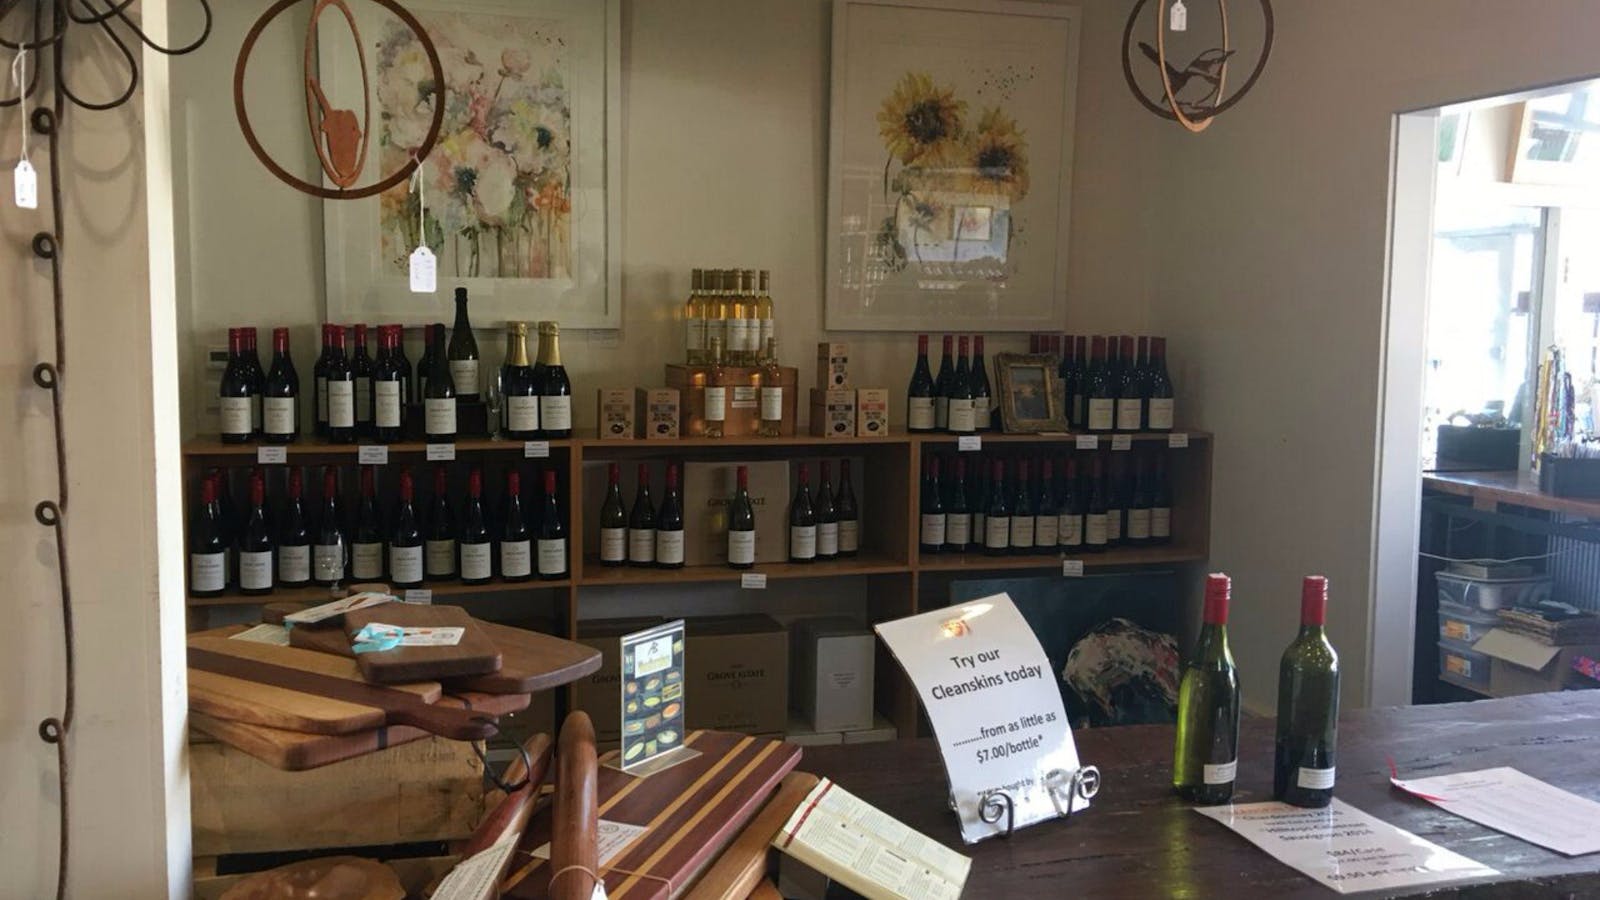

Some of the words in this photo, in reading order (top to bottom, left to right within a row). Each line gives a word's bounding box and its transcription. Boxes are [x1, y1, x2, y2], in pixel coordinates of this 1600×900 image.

[949, 655, 976, 669] Try
[977, 648, 1001, 663] our
[931, 674, 1004, 700] Cleanskins
[1004, 665, 1042, 683] today
[1008, 720, 1020, 733] as
[1020, 714, 1044, 729] little
[1045, 712, 1057, 723] as
